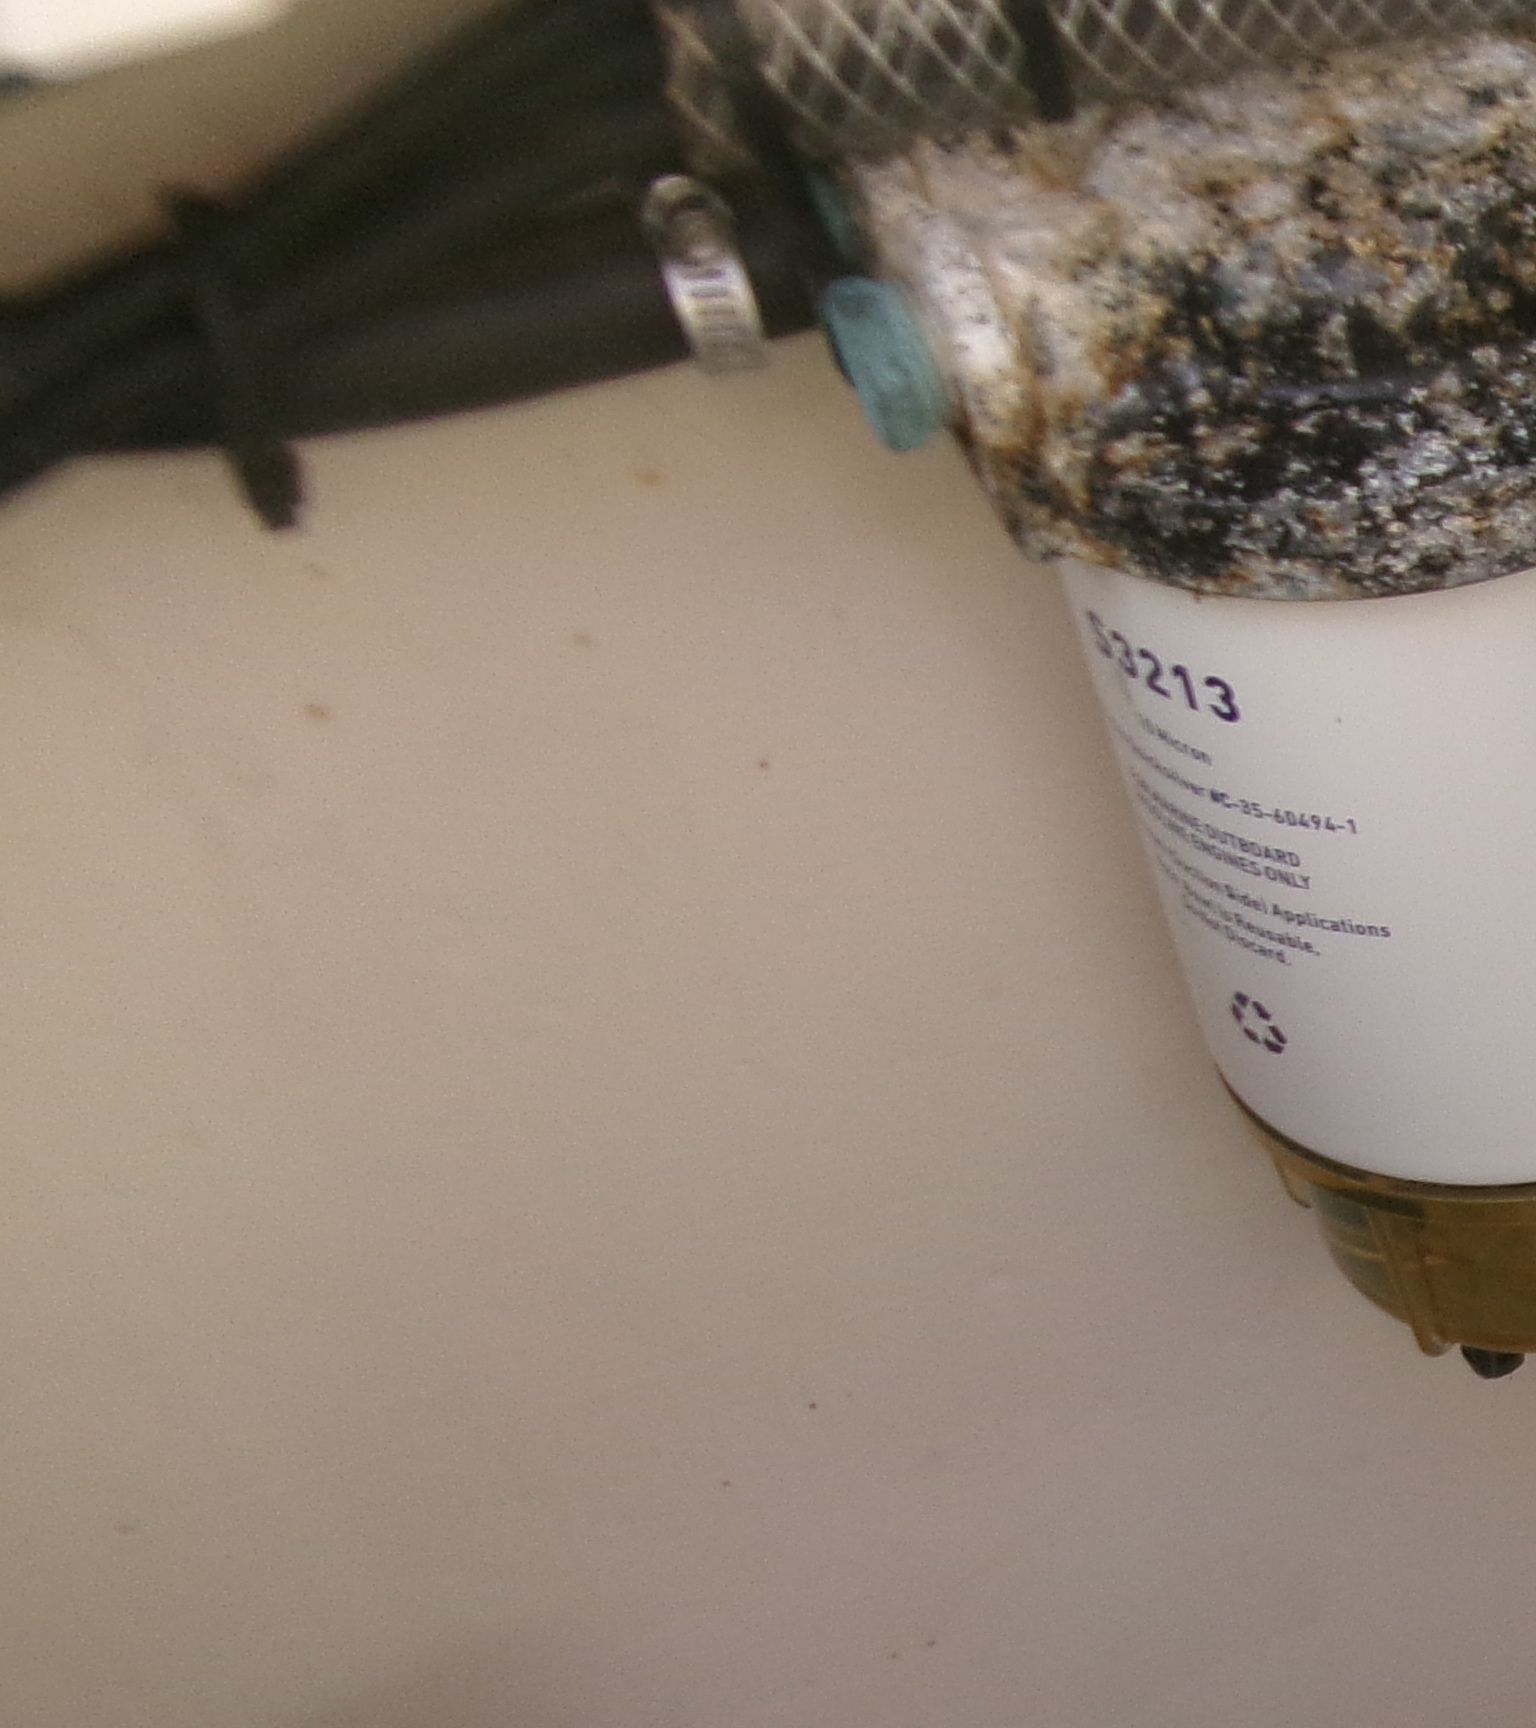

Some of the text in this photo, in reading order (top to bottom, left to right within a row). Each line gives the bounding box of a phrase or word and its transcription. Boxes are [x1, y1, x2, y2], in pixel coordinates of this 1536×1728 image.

[1205, 823, 1301, 868] OUTBOARD
[1264, 865, 1311, 890] ONLY
[1272, 903, 1392, 938] Applications
